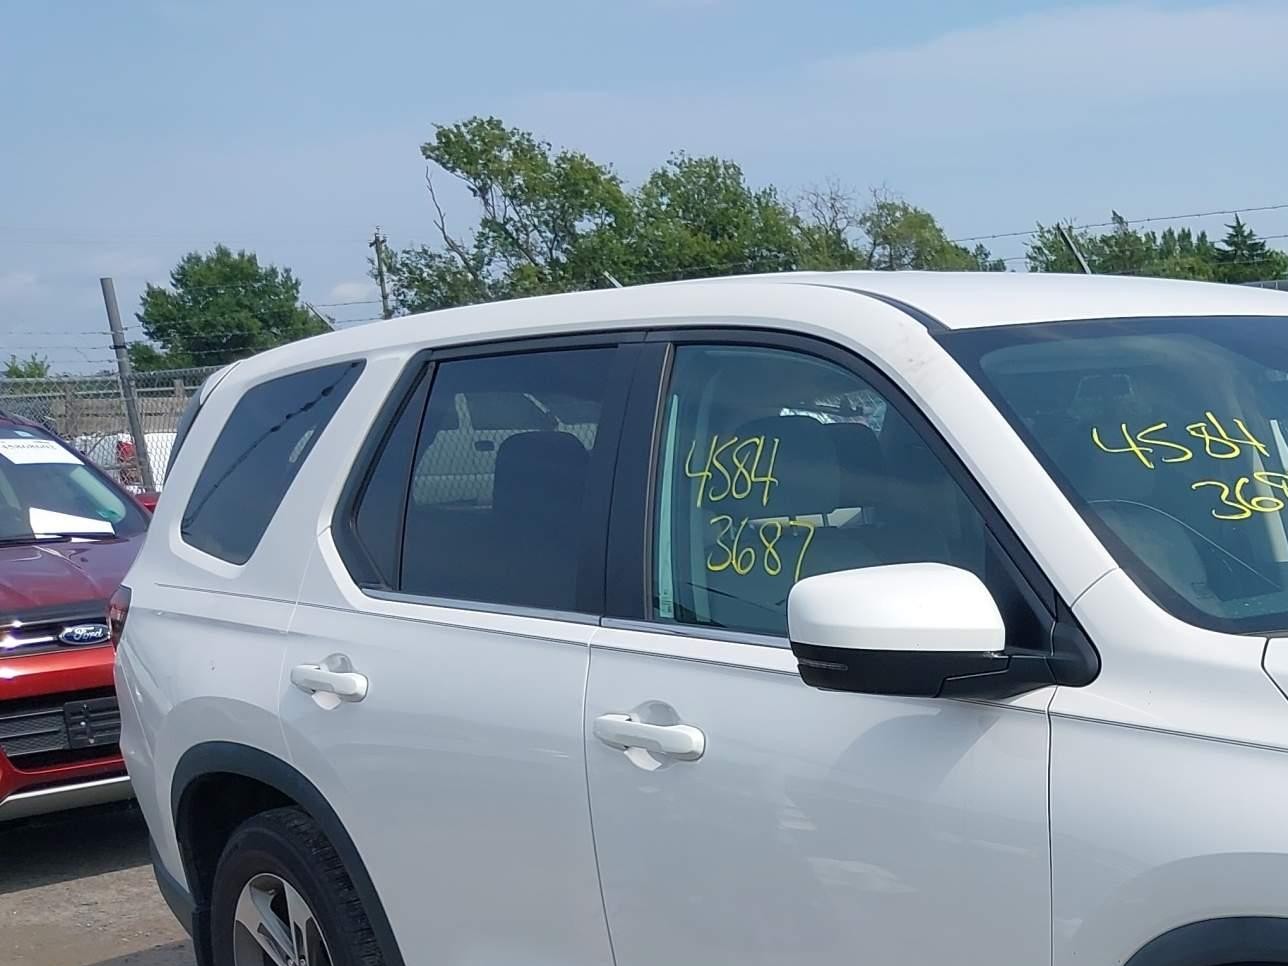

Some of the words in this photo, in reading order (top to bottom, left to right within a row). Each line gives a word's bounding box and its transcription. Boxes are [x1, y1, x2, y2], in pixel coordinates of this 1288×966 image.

[685, 434, 780, 508] 4584
[1091, 411, 1270, 470] 4584
[707, 514, 815, 582] 3687
[73, 626, 103, 640] Ford
